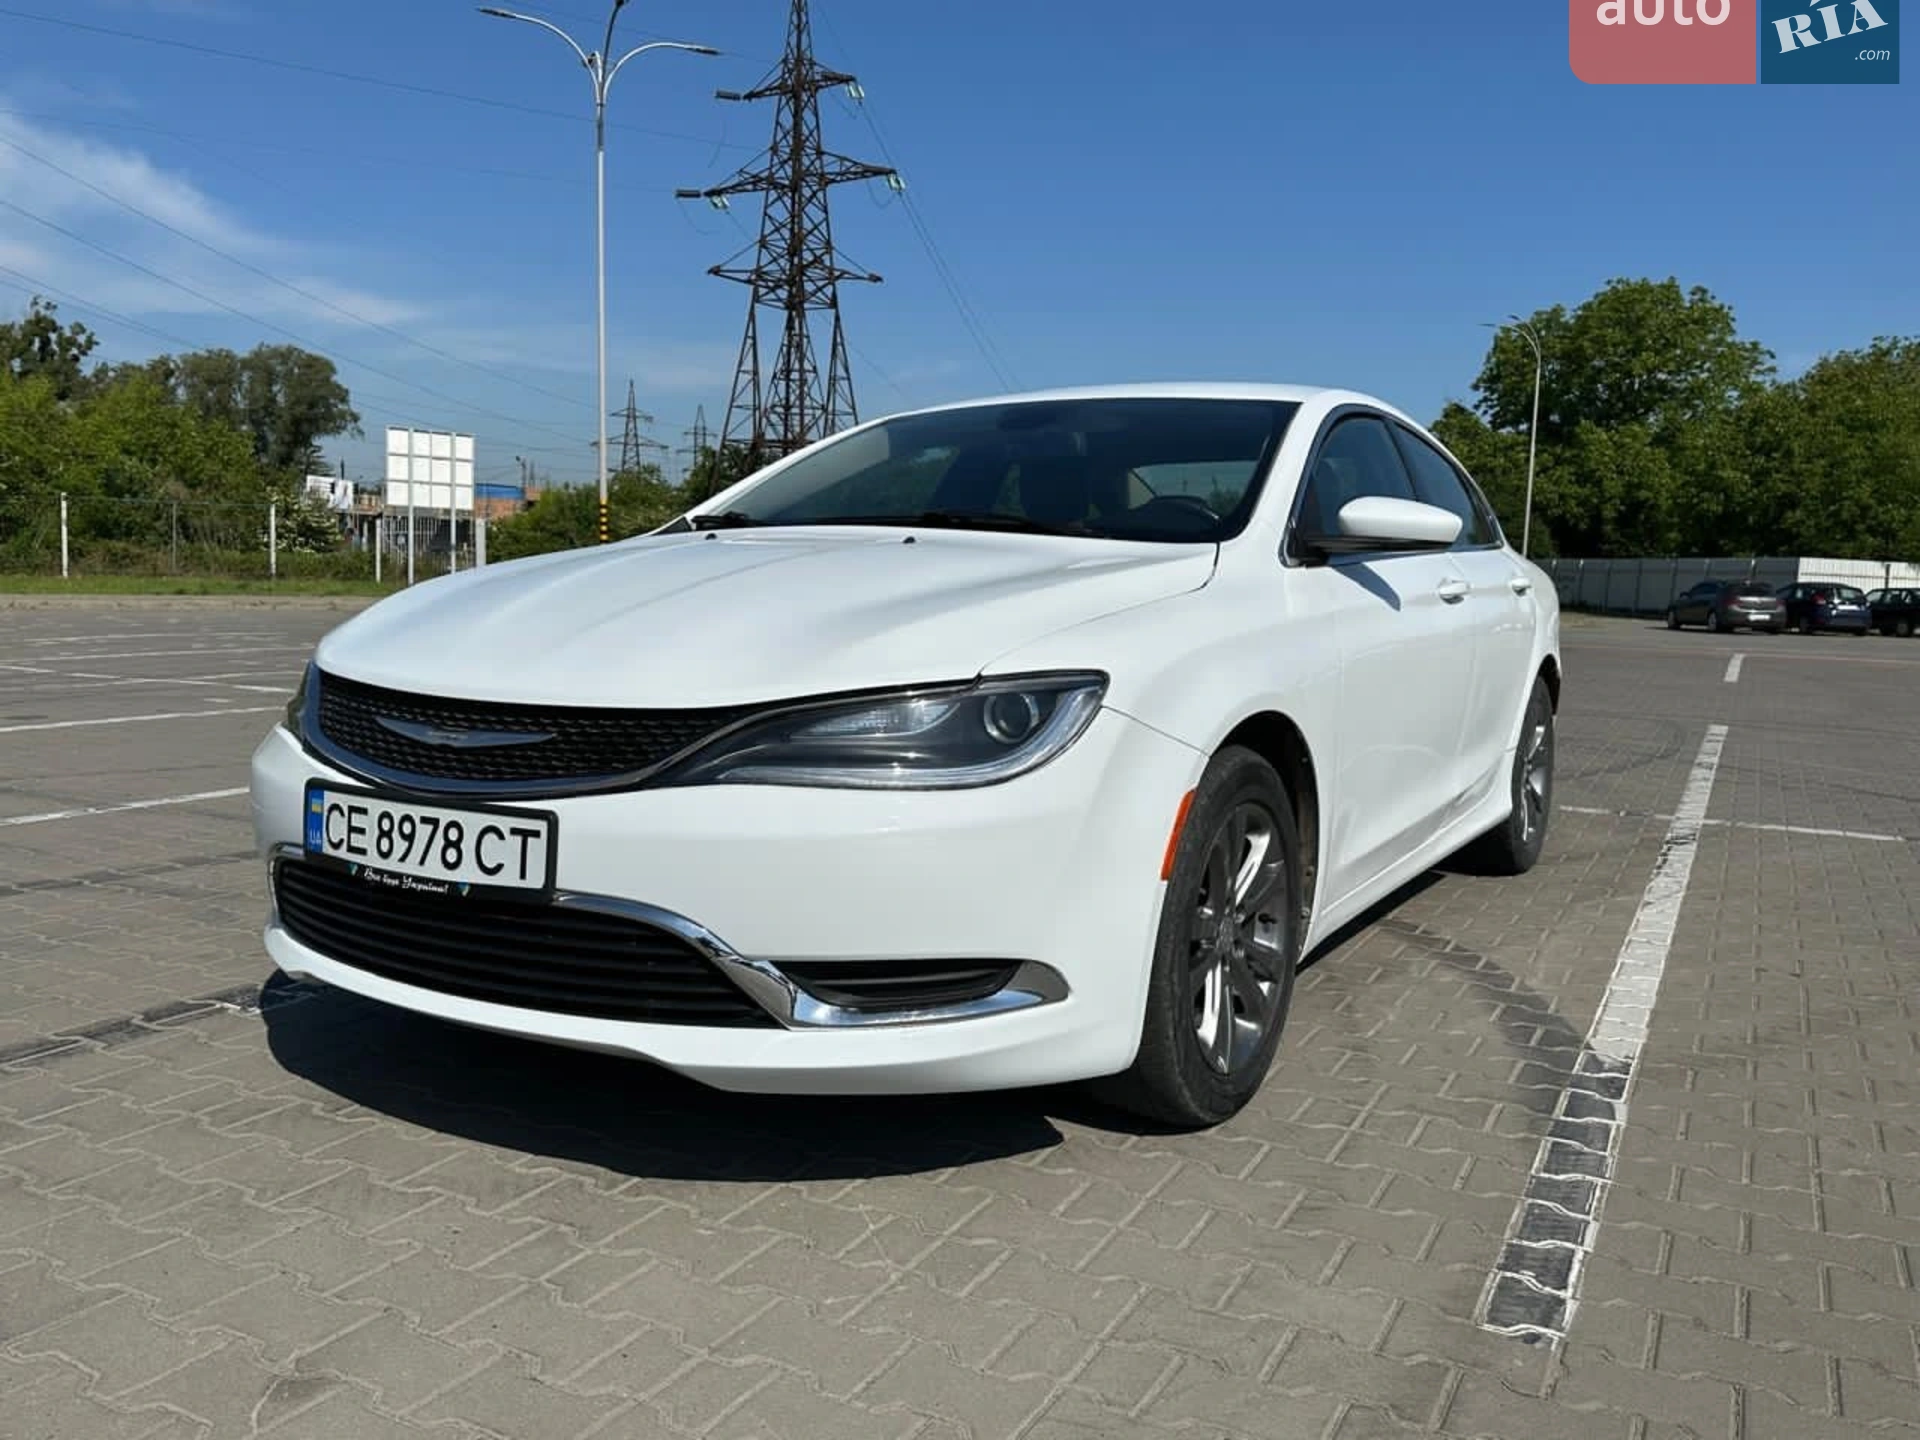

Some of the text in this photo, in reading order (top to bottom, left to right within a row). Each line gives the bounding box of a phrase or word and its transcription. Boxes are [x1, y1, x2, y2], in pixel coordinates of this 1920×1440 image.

[325, 803, 541, 881] CE 8978 CT
